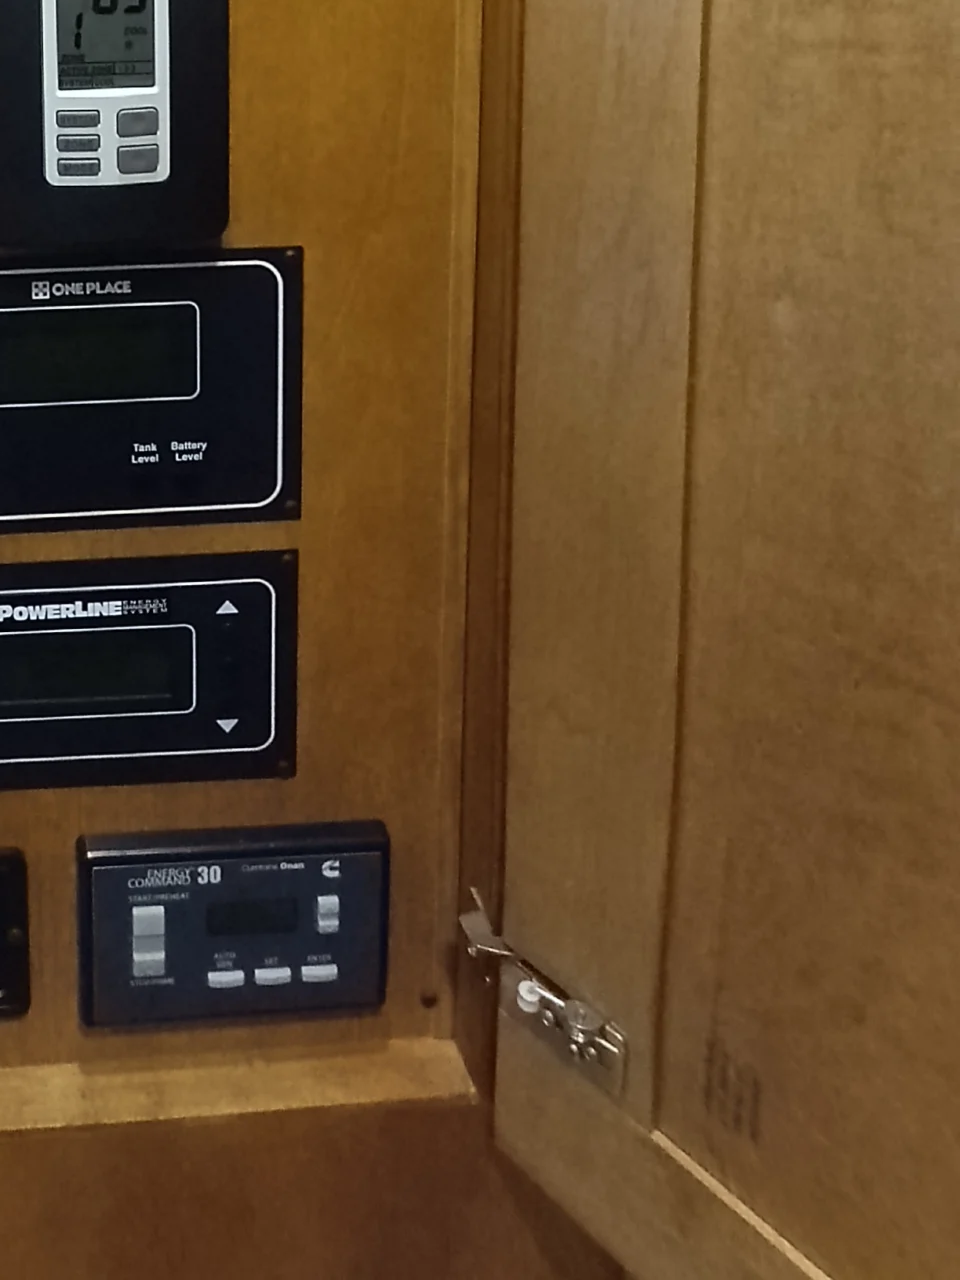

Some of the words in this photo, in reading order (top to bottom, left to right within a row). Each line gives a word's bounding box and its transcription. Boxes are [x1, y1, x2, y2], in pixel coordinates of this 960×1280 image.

[52, 283, 83, 296] ONE
[86, 281, 132, 294] PLACE
[133, 442, 157, 452] Tank
[171, 440, 208, 452] Battery
[131, 454, 159, 463] Level
[175, 452, 203, 461] Level
[280, 862, 305, 870] Onan
[147, 866, 191, 879] ENERGY
[197, 865, 221, 884] 30
[127, 875, 191, 888] COMMAND
